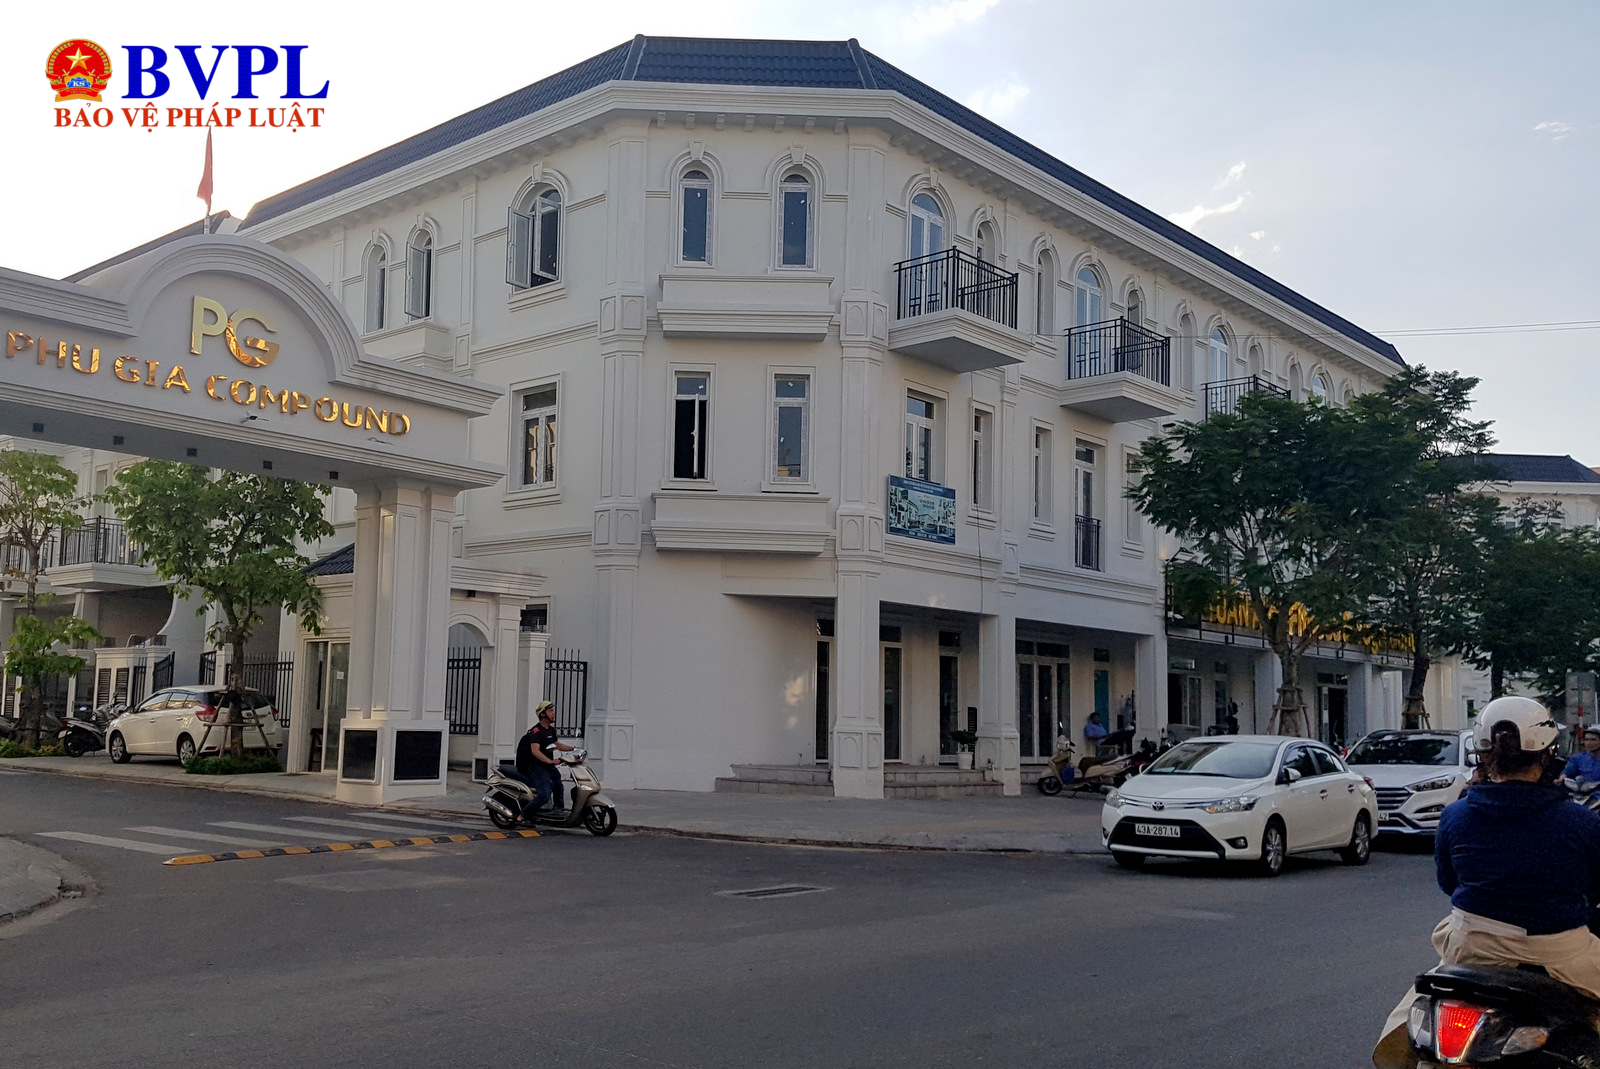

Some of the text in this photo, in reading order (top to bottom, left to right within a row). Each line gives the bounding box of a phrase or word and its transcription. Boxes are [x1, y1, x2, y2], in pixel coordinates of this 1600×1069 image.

[189, 295, 280, 368] PG
[6, 329, 412, 436] PHU GIA COMPOUND
[1136, 824, 1179, 837] 43A-287.14
